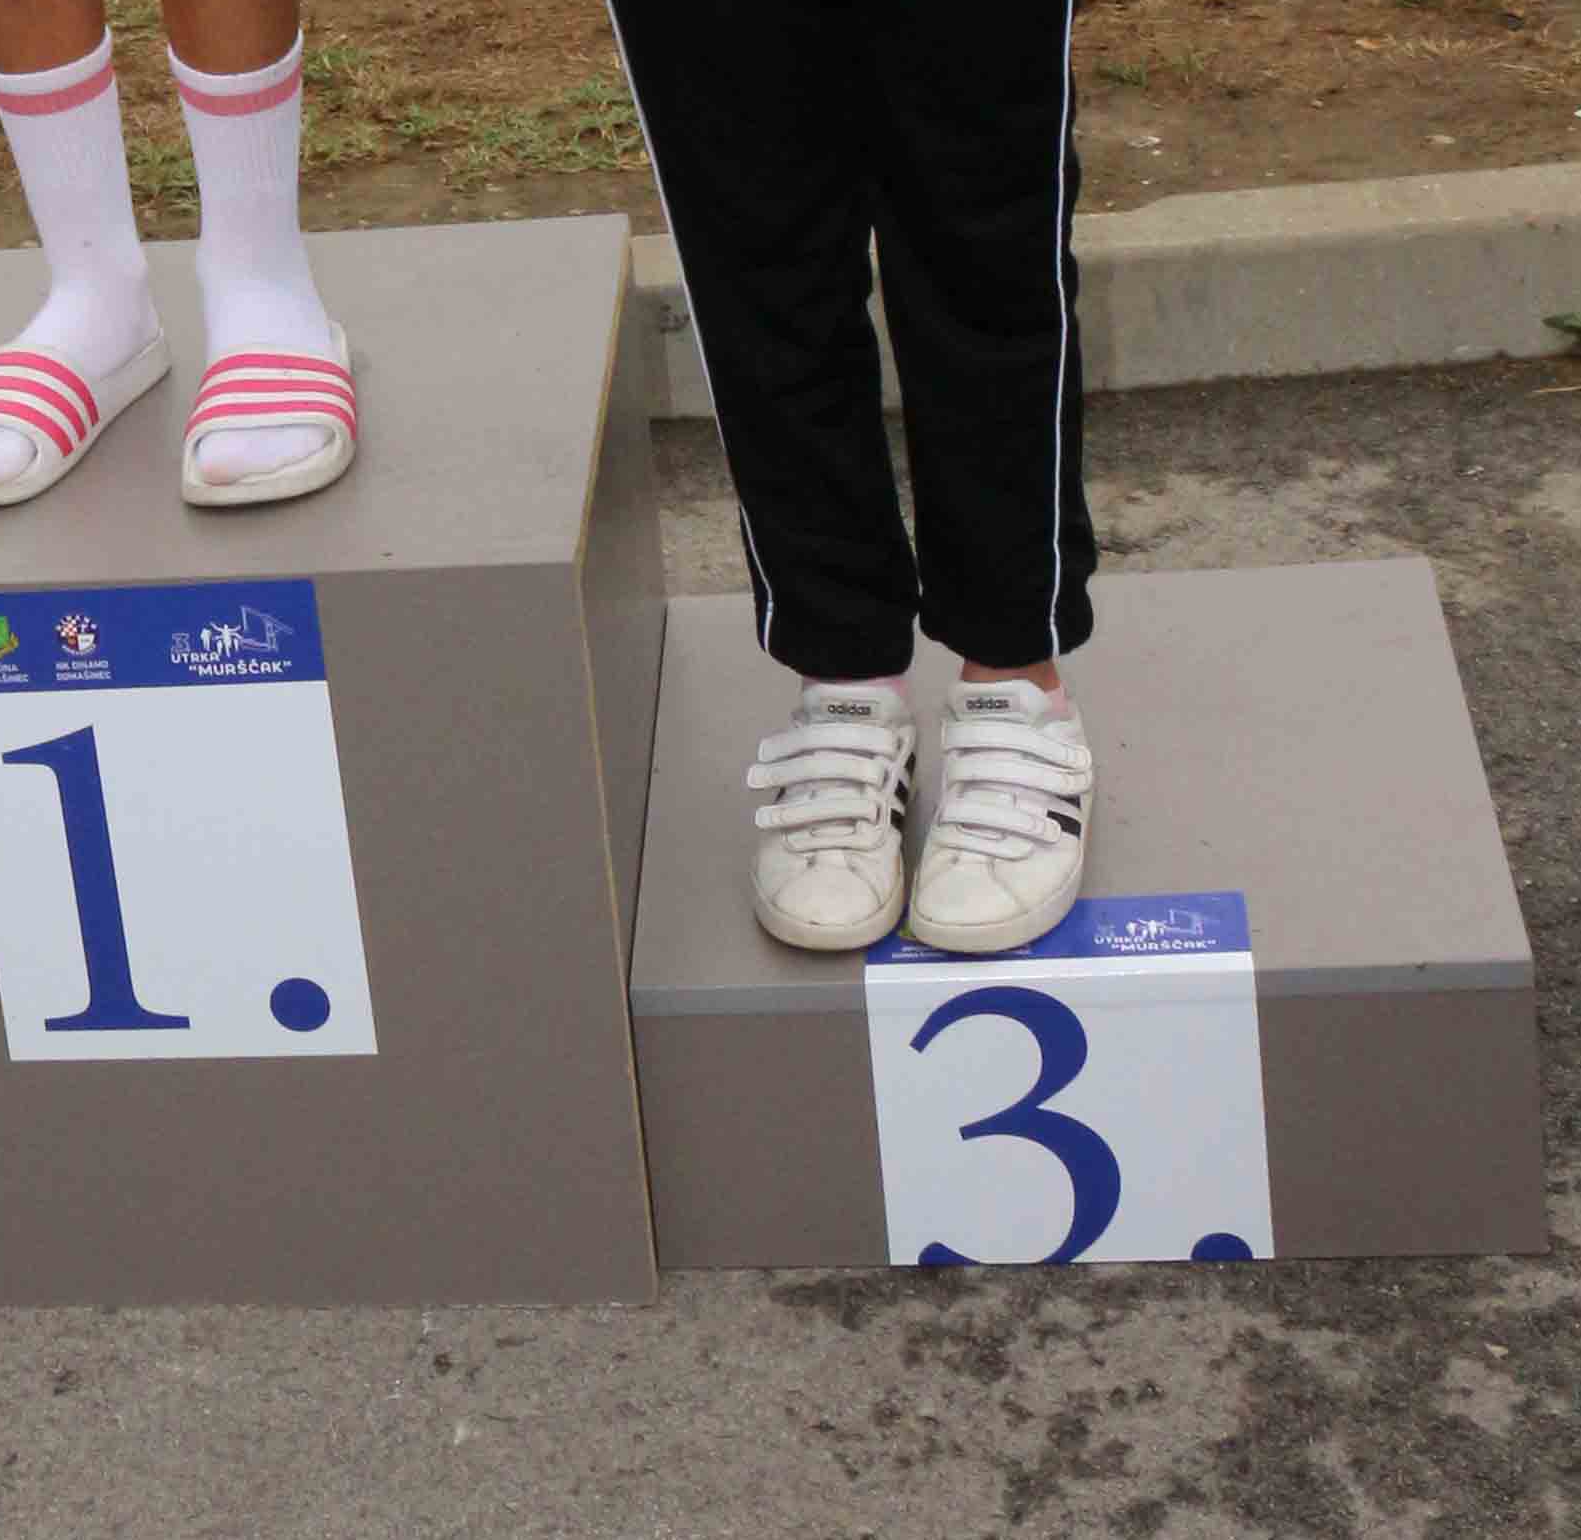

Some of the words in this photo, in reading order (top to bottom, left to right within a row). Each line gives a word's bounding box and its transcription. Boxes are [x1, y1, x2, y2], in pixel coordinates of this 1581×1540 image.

[170, 650, 221, 664] UTRKA
[826, 701, 873, 717] adidas
[965, 696, 1011, 712] adidas
[2, 724, 331, 1033] 1.
[908, 985, 1254, 1264] 3.
